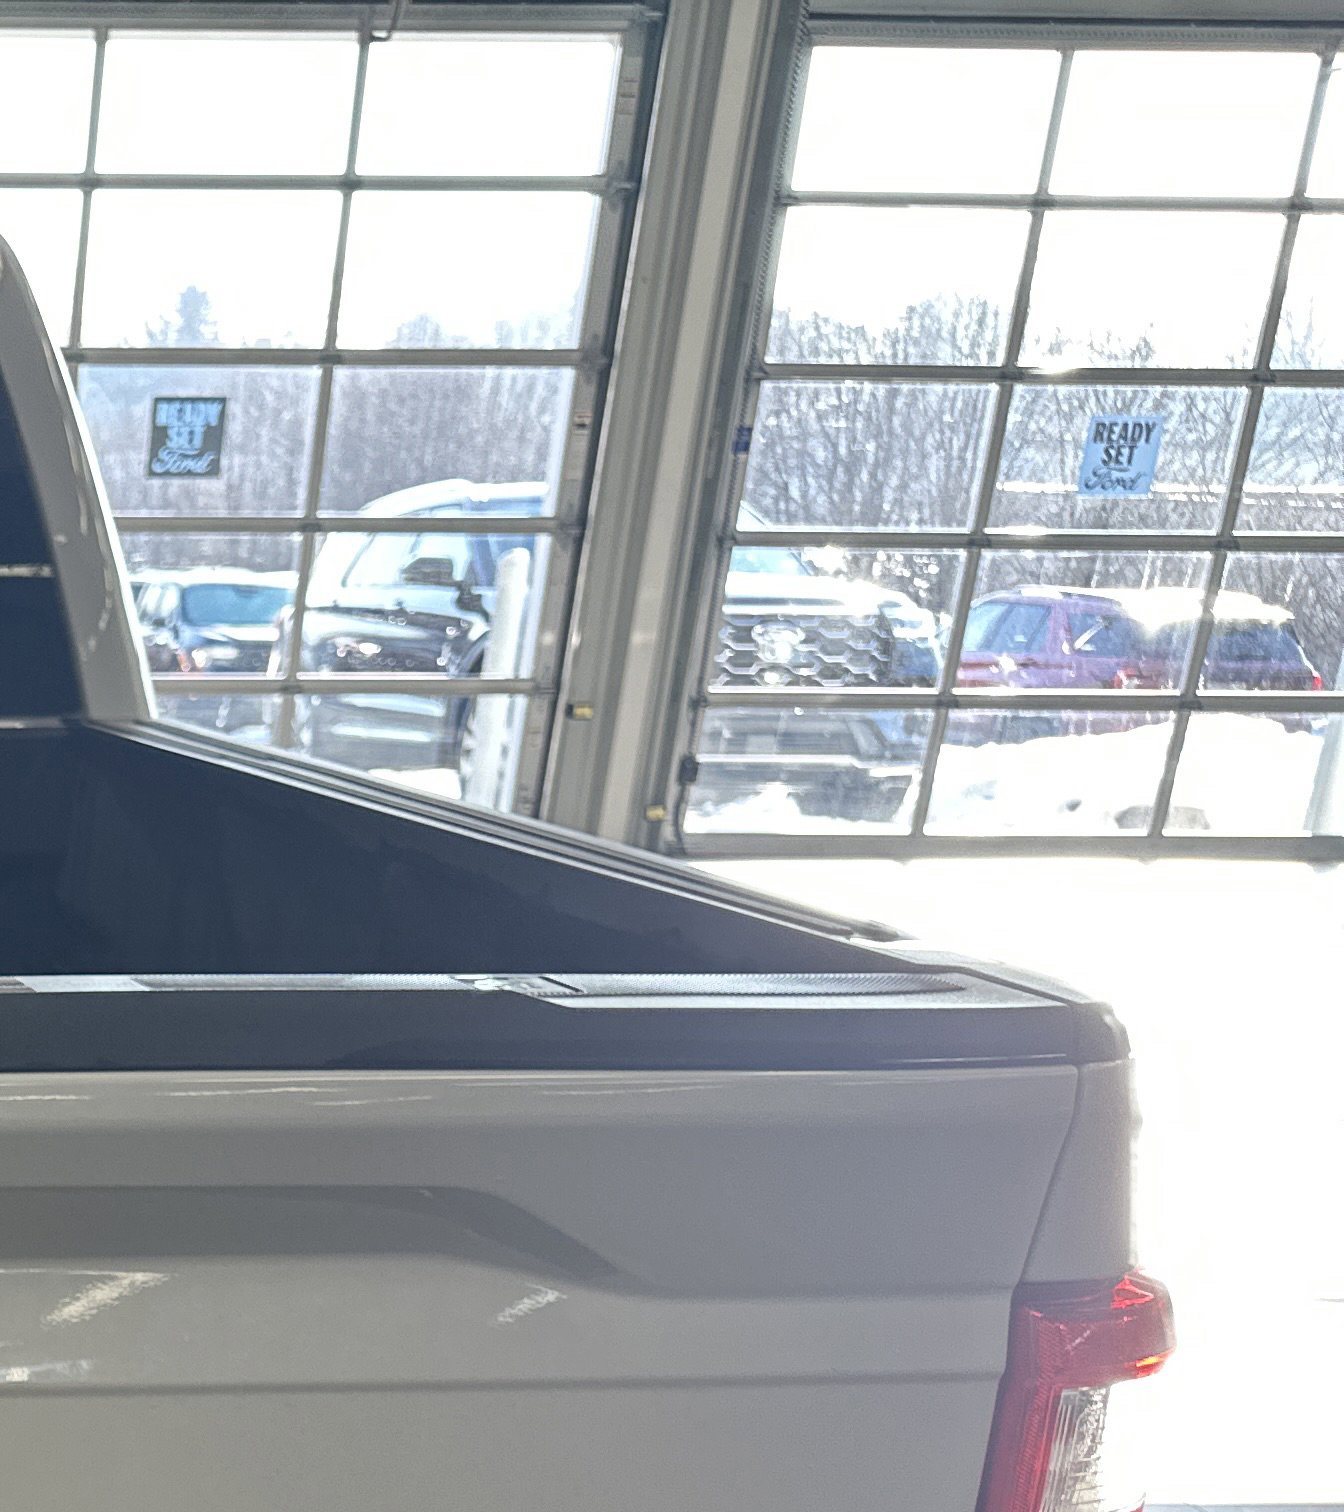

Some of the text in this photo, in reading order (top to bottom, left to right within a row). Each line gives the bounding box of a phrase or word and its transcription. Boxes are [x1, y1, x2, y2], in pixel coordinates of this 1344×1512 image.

[1092, 421, 1157, 444] READY
[151, 446, 219, 474] Ford
[1101, 444, 1138, 467] SET
[1084, 466, 1149, 491] Ford
